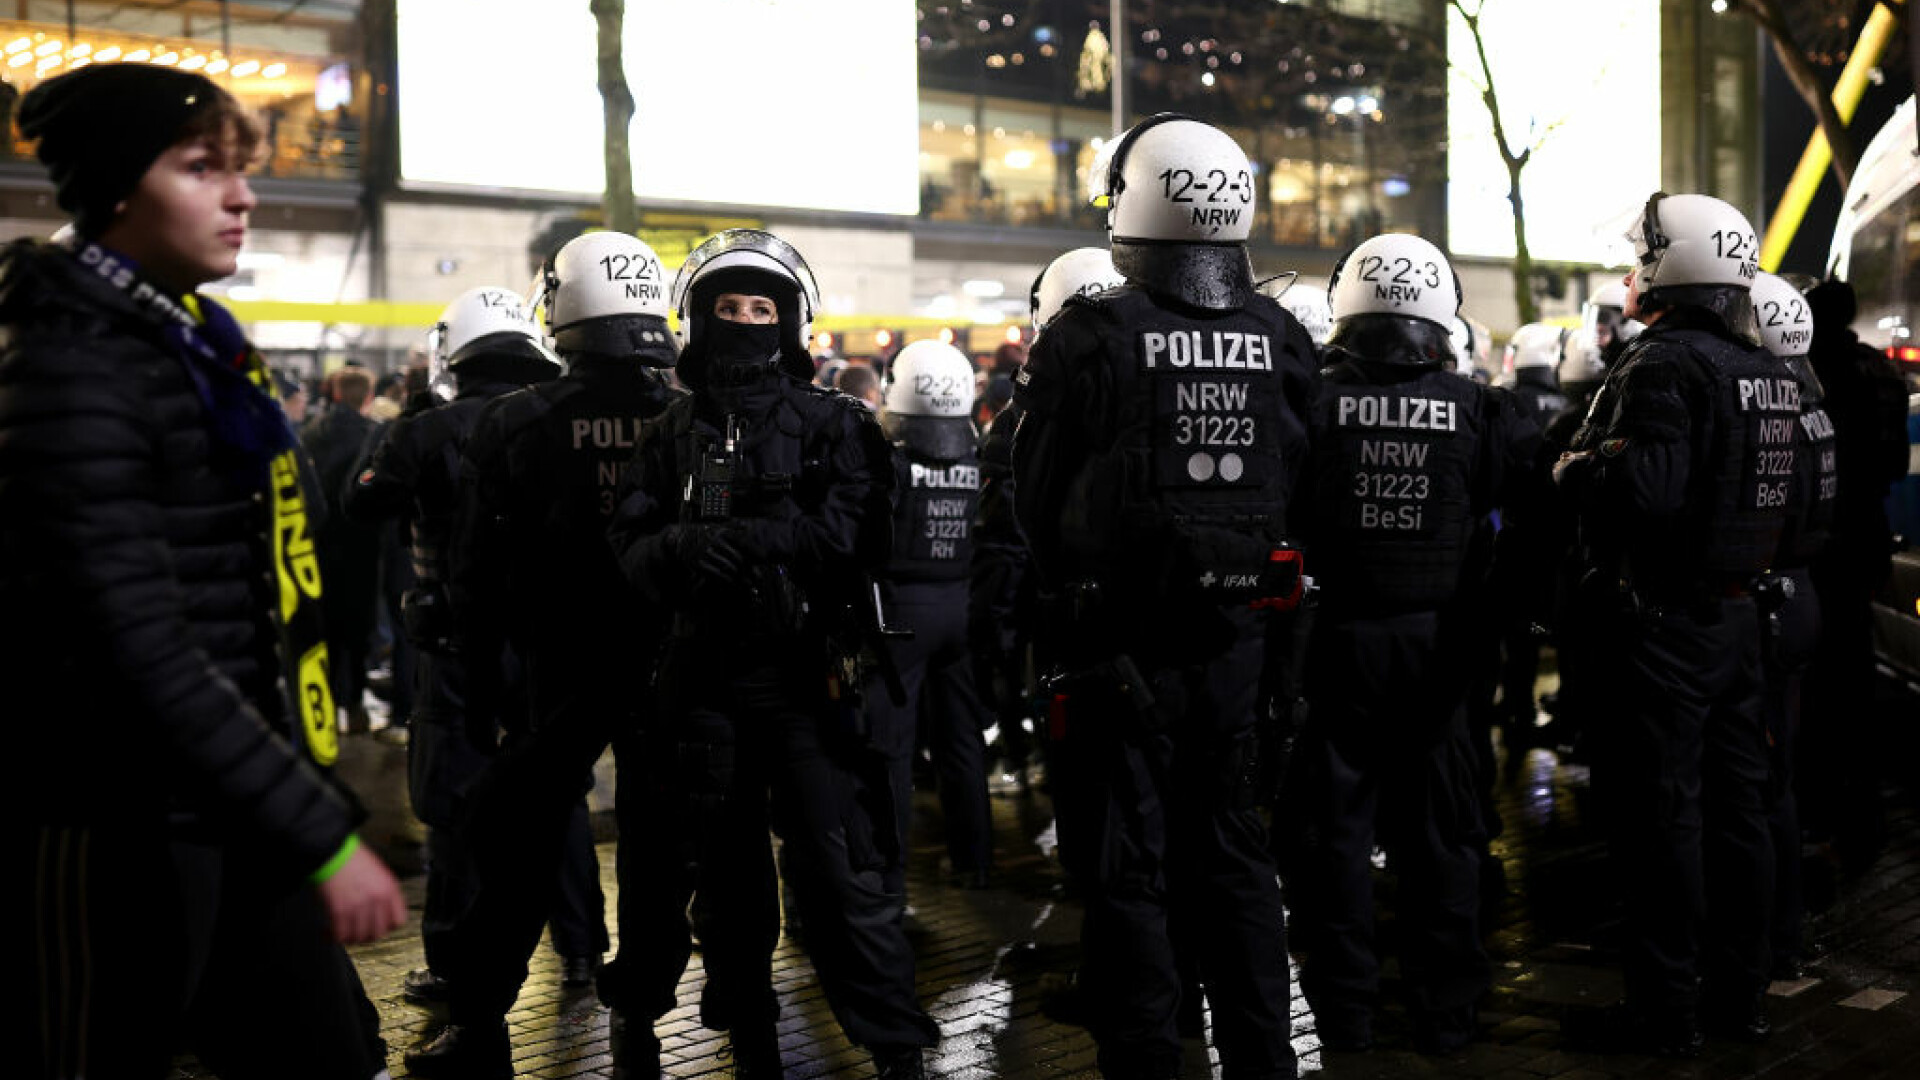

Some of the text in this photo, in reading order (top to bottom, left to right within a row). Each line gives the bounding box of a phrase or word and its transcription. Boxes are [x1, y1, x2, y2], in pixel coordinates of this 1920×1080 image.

[1191, 207, 1241, 225] NRW
[1375, 284, 1422, 302] NRW
[1144, 331, 1273, 370] POLIZEI
[1177, 382, 1249, 411] NRW
[1339, 396, 1456, 431] POLIZEI
[1176, 415, 1255, 447] 31223
[1760, 419, 1793, 443] NRW
[1361, 440, 1430, 468] NRW
[1354, 472, 1430, 499] 31223
[1756, 482, 1788, 507] BeSi
[927, 499, 967, 517] NRW
[1361, 503, 1423, 530] BeSi
[1224, 574, 1260, 588] IFAK
